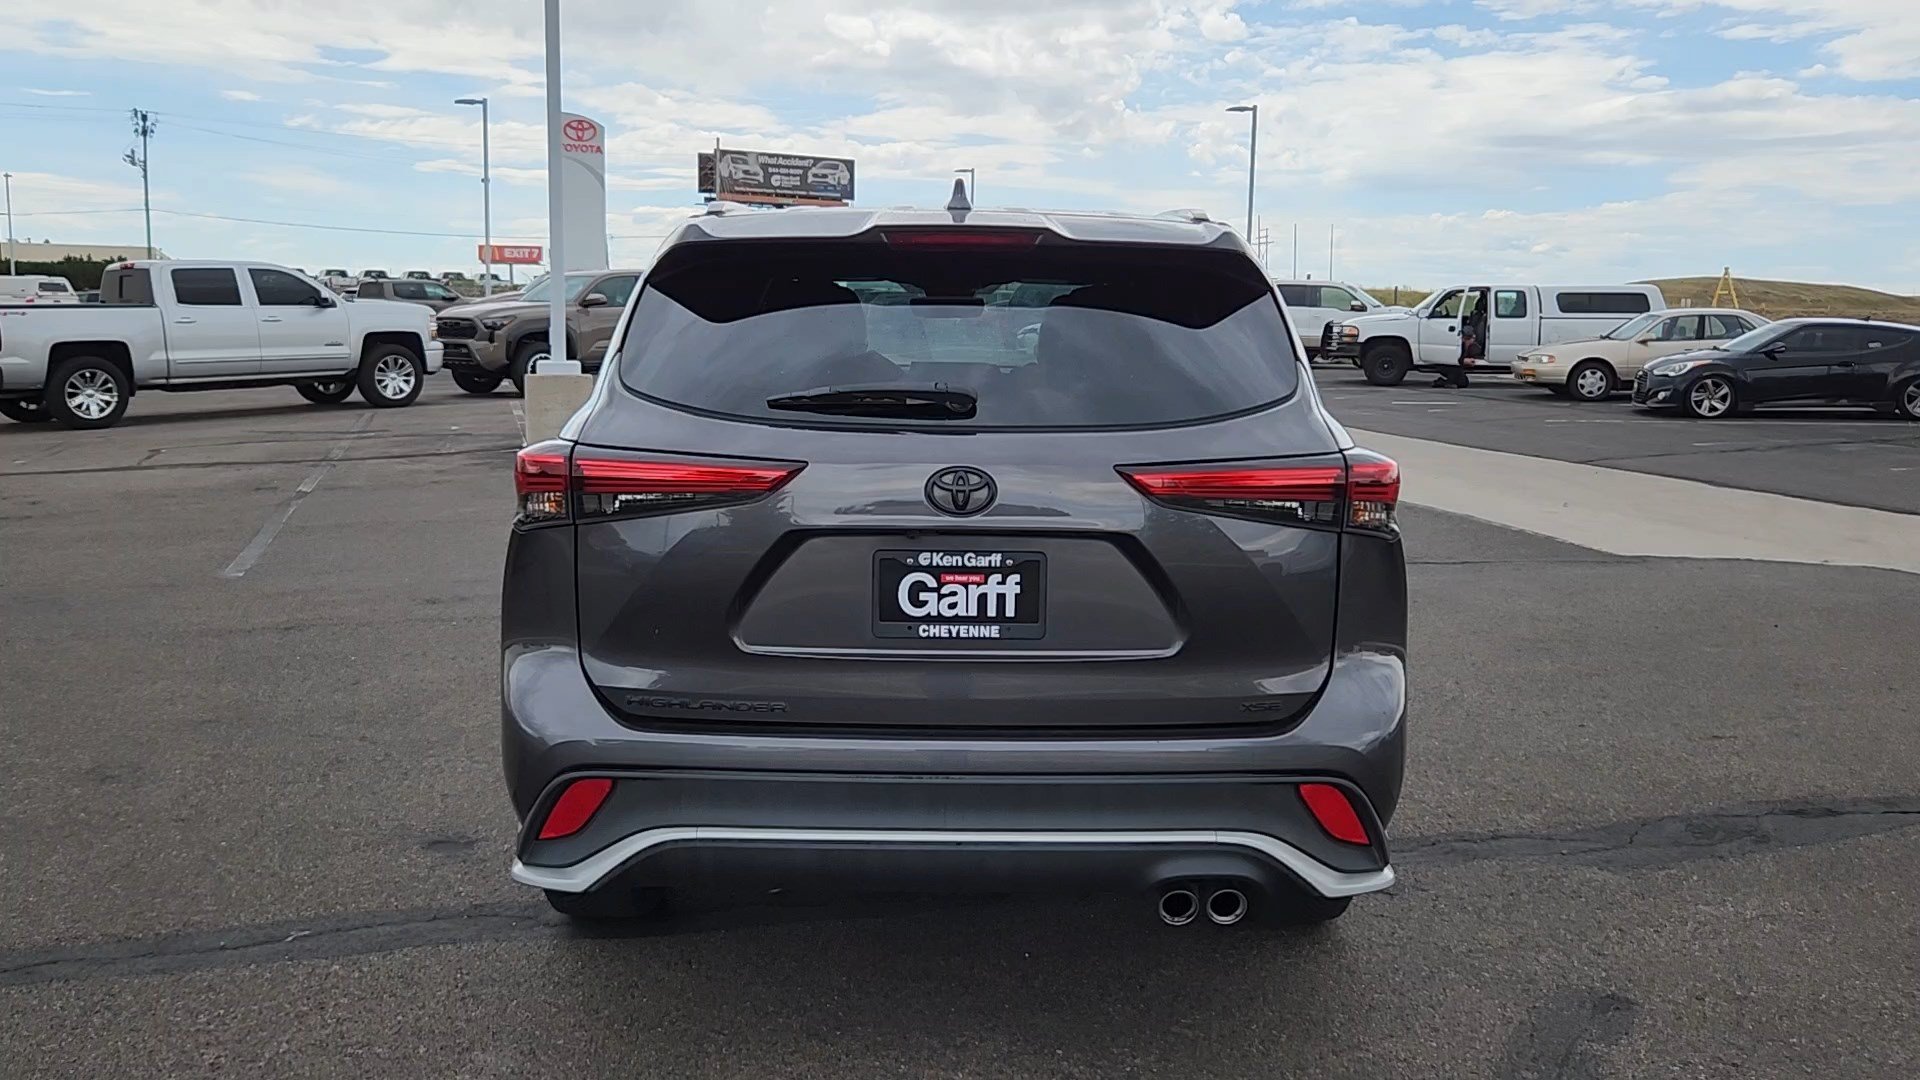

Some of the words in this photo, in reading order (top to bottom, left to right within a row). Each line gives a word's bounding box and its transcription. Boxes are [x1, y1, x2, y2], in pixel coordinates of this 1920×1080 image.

[561, 143, 603, 155] OYOTA
[757, 155, 777, 165] What
[777, 156, 814, 167] Accident?
[504, 248, 532, 258] EXIT
[532, 248, 540, 258] 7
[932, 552, 962, 567] Ken
[963, 553, 1002, 567] Garff
[897, 572, 1021, 618] Garff
[918, 625, 1000, 638] CHEYENNE
[626, 695, 788, 713] HIGHLANDER
[1241, 702, 1281, 712] XSE
